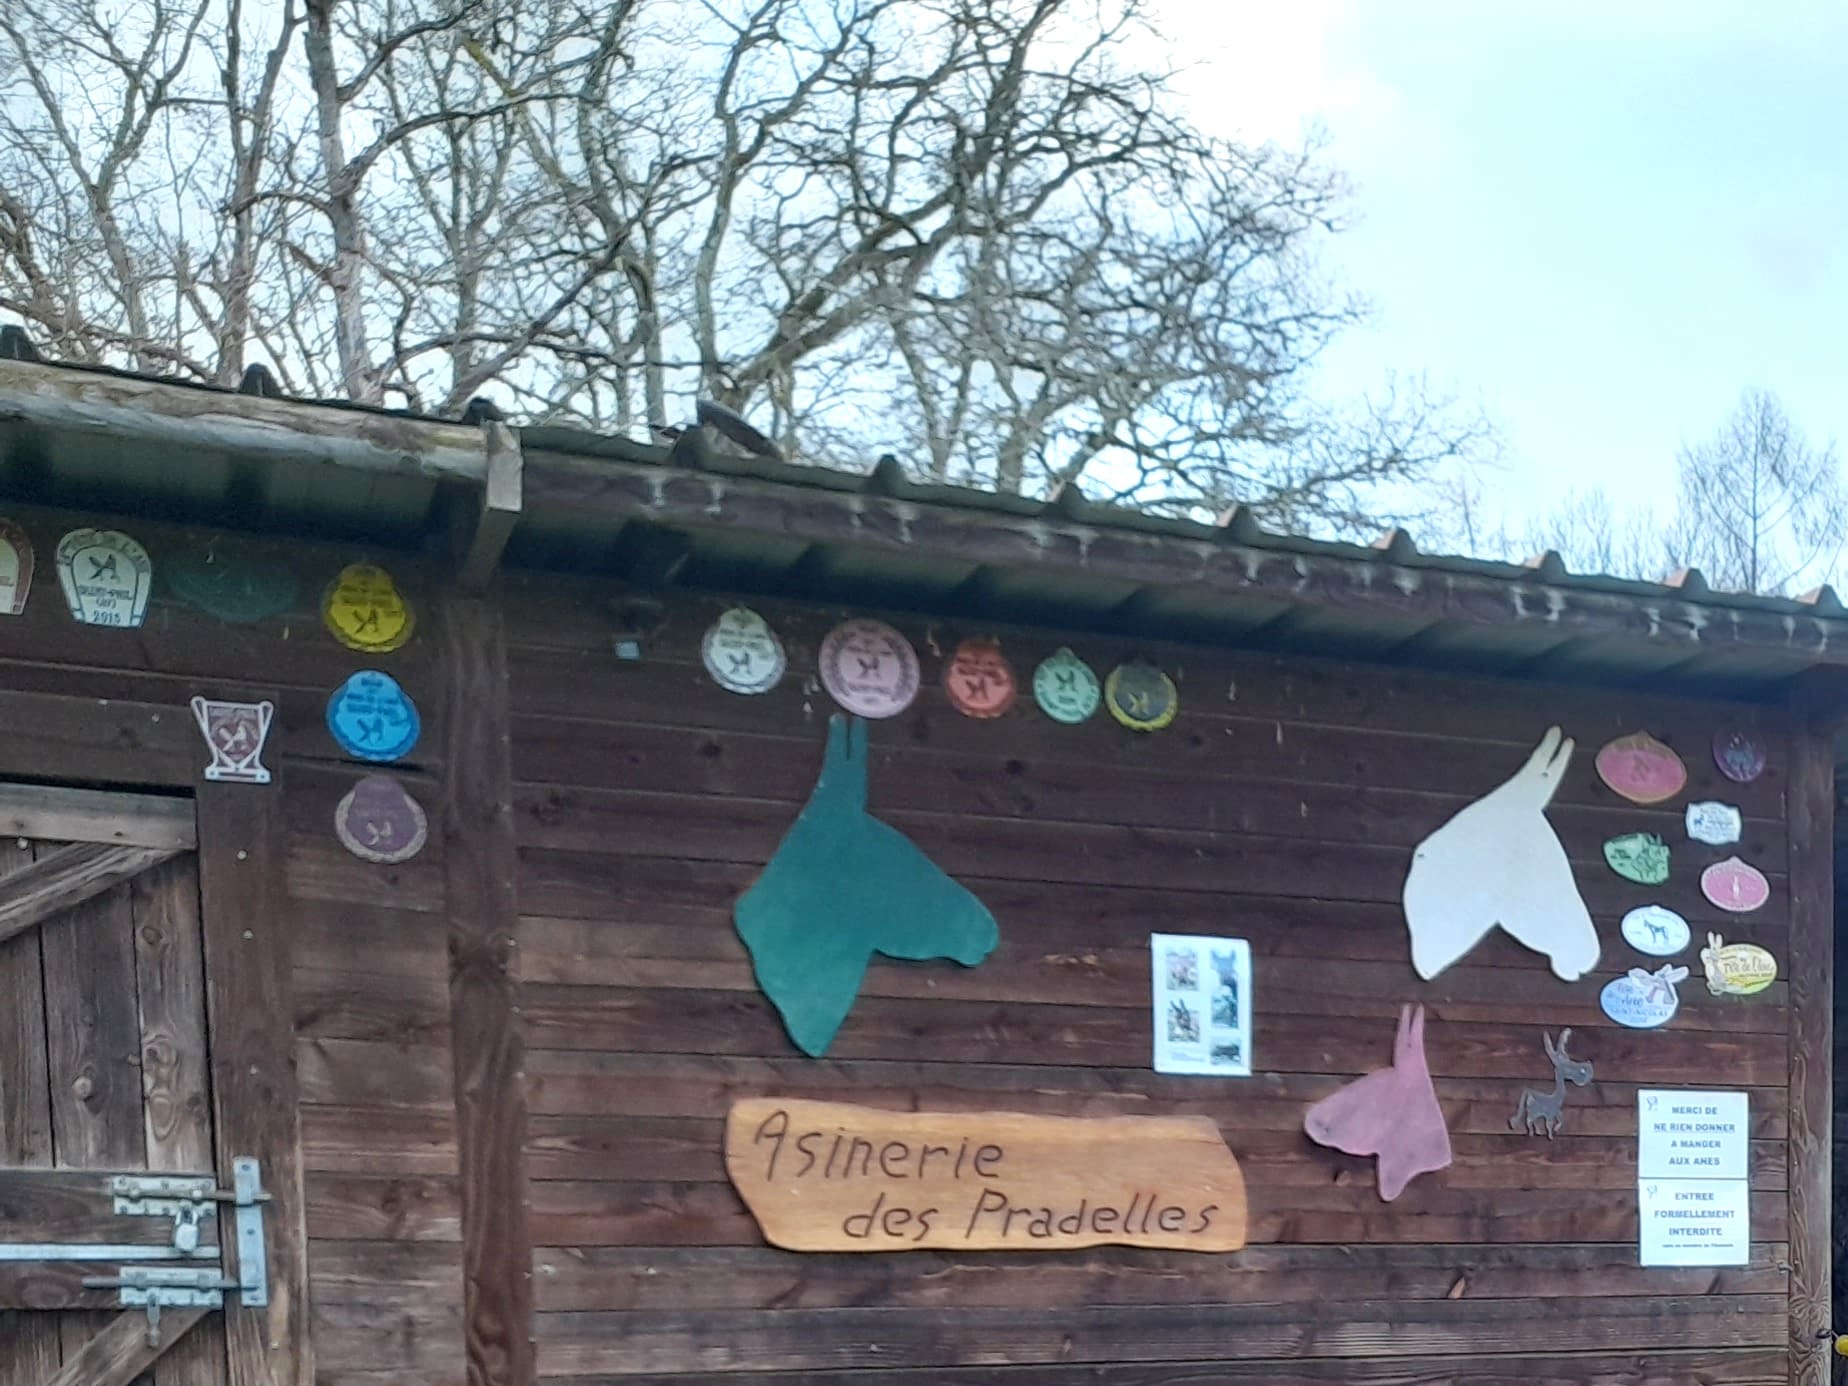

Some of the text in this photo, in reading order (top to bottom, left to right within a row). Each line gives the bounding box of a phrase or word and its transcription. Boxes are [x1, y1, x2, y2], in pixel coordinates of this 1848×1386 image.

[1671, 1106, 1718, 1115] MERCI DE
[1653, 1123, 1735, 1133] NE RIEN DONNER
[754, 1109, 1003, 1181] Asinerie
[1671, 1140, 1721, 1148] A MANGER
[1668, 1157, 1721, 1166] AUX ANES
[1674, 1192, 1715, 1201] ENTREE
[842, 1187, 1219, 1241] des Pradelles
[1653, 1209, 1736, 1219] FORMELLEMENT
[1668, 1227, 1723, 1237] INTERDITE
